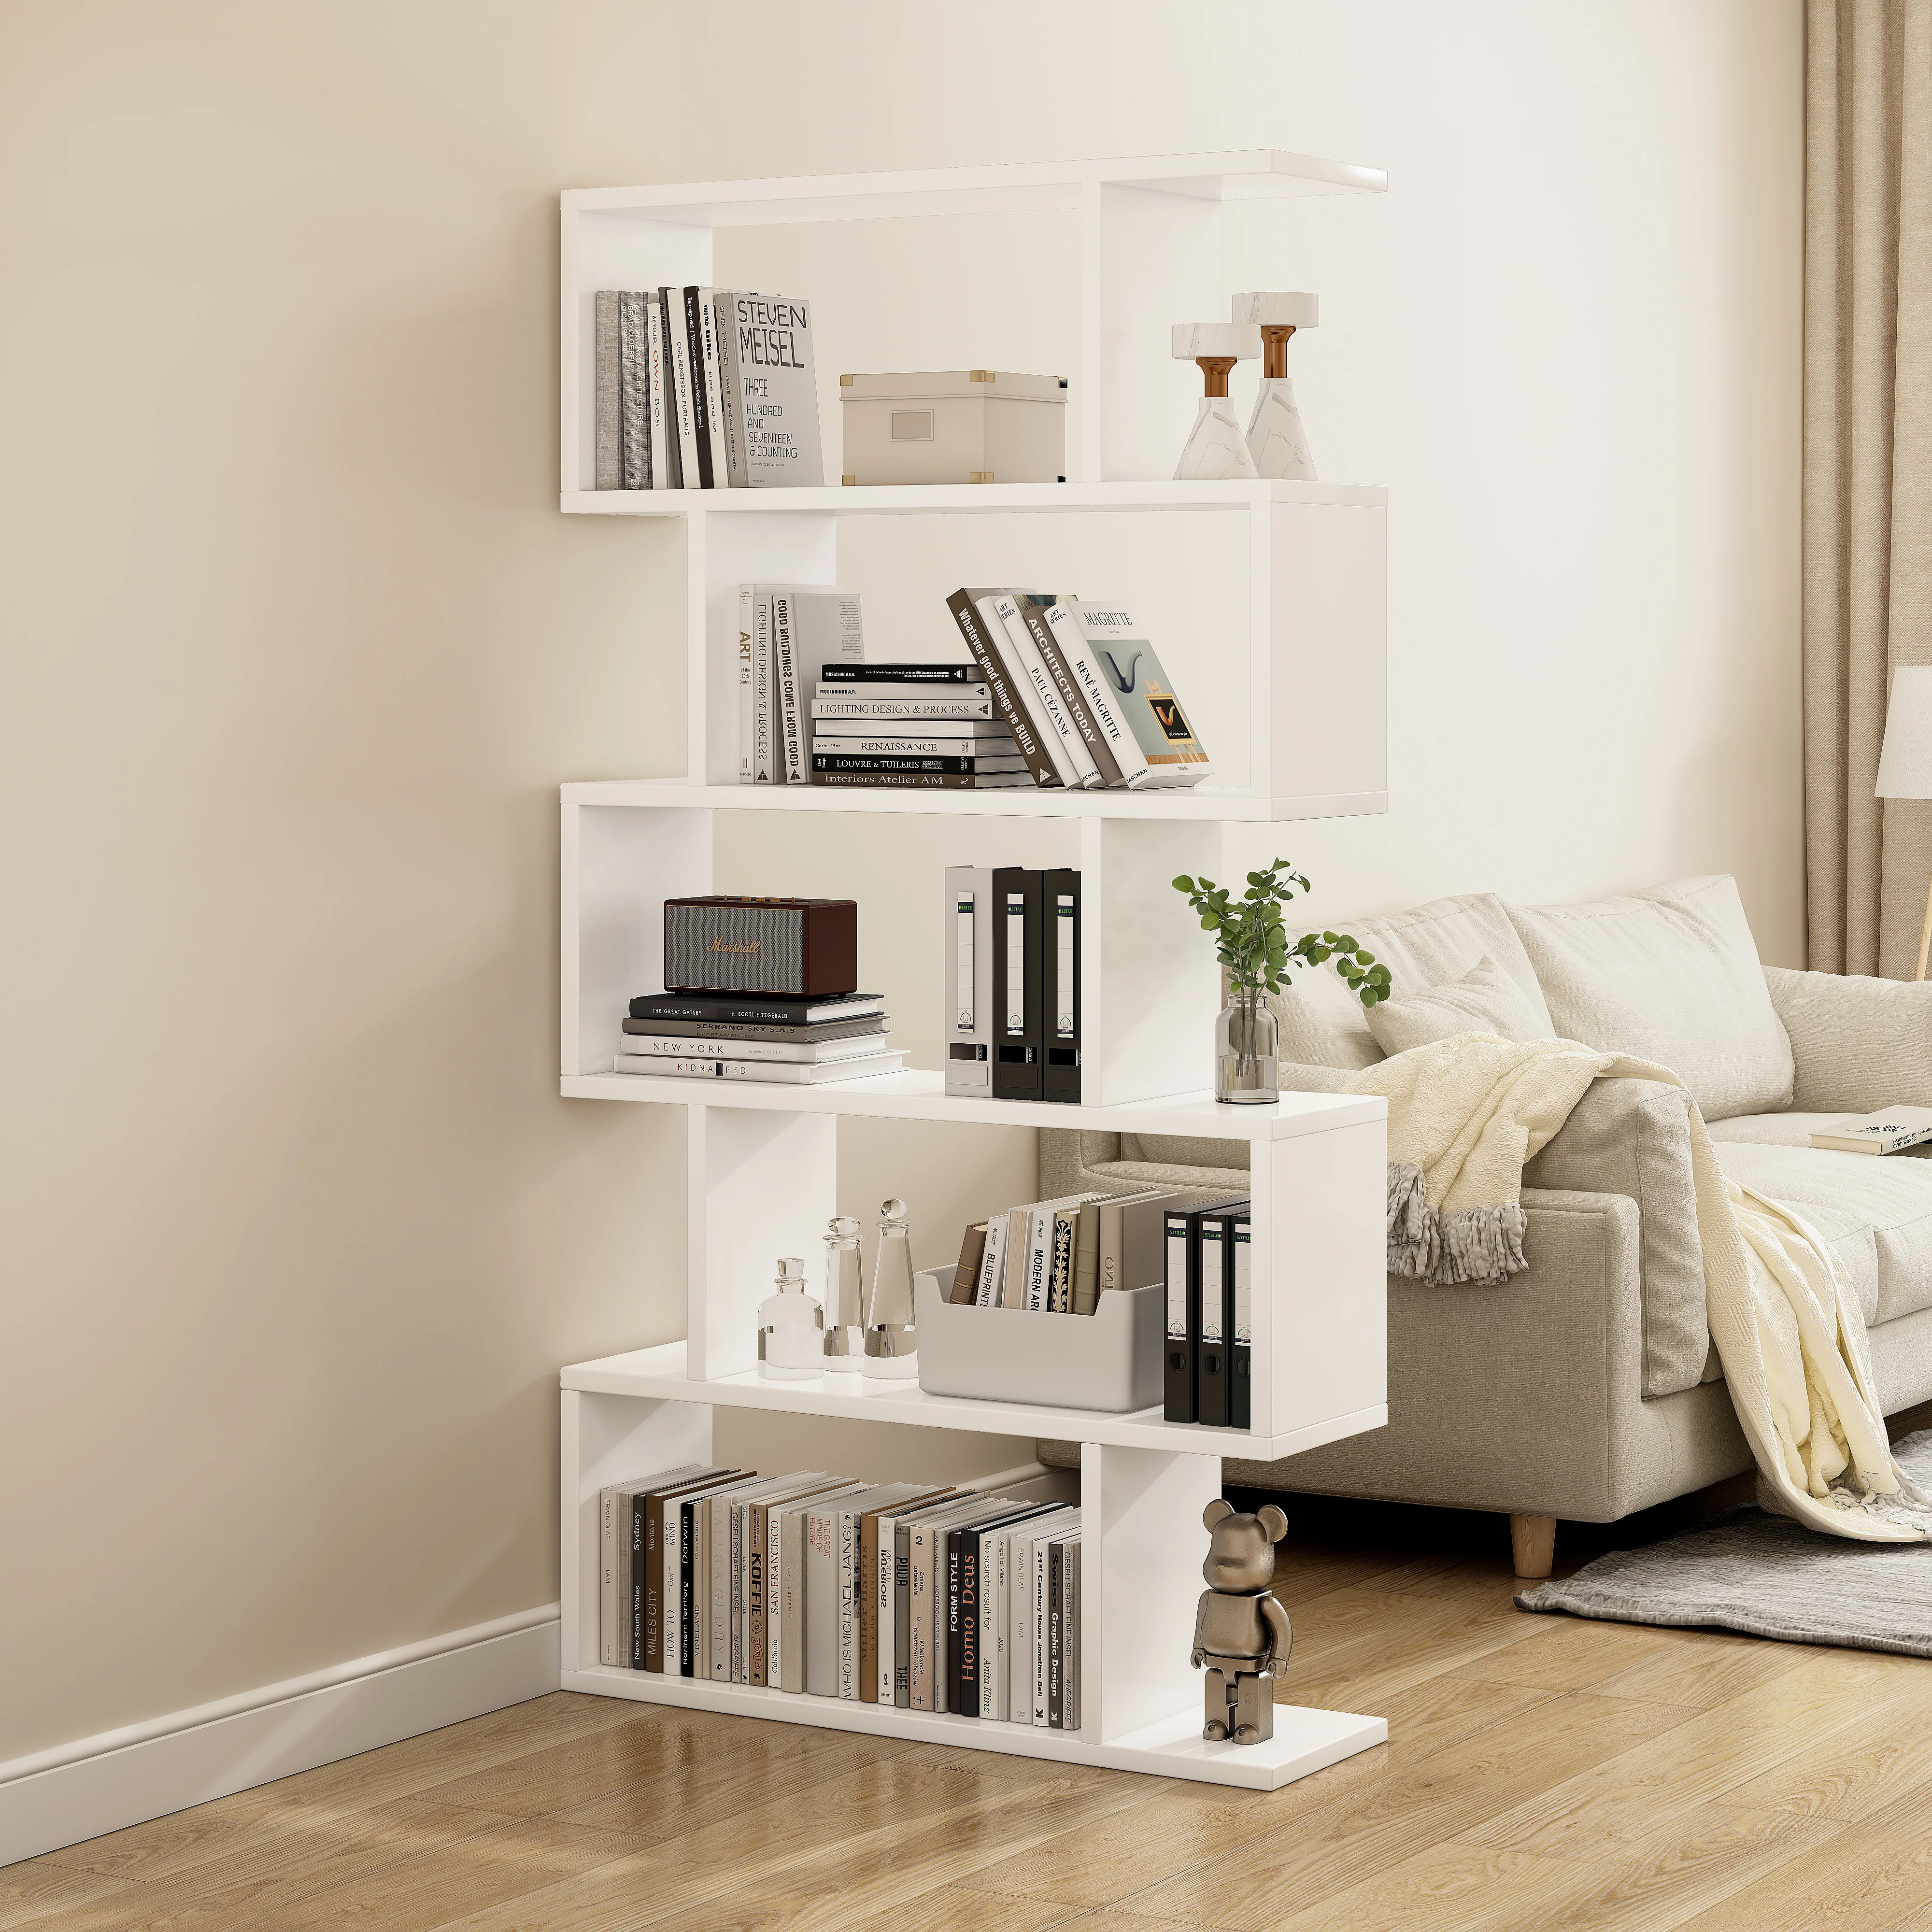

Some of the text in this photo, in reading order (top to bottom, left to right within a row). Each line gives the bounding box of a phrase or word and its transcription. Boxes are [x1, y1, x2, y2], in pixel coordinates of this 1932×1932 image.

[738, 300, 807, 328] STEVEN
[739, 327, 805, 368] MEISEL
[744, 377, 768, 398] THREE
[746, 404, 782, 416] HUNDRED
[748, 418, 764, 429] AND
[749, 432, 792, 444] SEVENTEEN
[750, 445, 798, 458] & COUNTING
[1050, 609, 1059, 618] ART
[1050, 612, 1066, 625] SERIES
[1083, 612, 1133, 625] MAGRITTE
[740, 631, 751, 662] ART
[959, 608, 1036, 755] Whatever good things ve BUILD
[1028, 618, 1097, 743] ARCHITECTS TODAY
[820, 704, 969, 714] LIGHTING DESIGN & PROCESS
[1031, 667, 1071, 738] PAUL CÉZANNE
[1076, 660, 1121, 742] RENÉ MAGRITTE
[861, 742, 938, 752] RENAISSANCE
[836, 759, 872, 767] LOUVRE
[880, 760, 919, 768] TUILERIS
[825, 774, 944, 784] Interiors Atelier AM
[706, 935, 761, 953] Marshall
[653, 1042, 724, 1054] NEW YORK
[816, 1543, 823, 1552] OF
[984, 1540, 992, 1553] No
[770, 1520, 779, 1614] SAN FRANCISCO
[896, 1557, 908, 1587] PUUR
[752, 1552, 762, 1617] KOFFIE
[648, 1587, 657, 1655] MILES CITY
[843, 1525, 852, 1698] WHO IS MICHAEL JANG?
[962, 1555, 975, 1682] Homo Deus
[667, 1609, 675, 1658] HOW TO
[751, 1636, 763, 1670] STORIES
[896, 1666, 908, 1690] THEE
[983, 1658, 992, 1714] Anita Klinz
